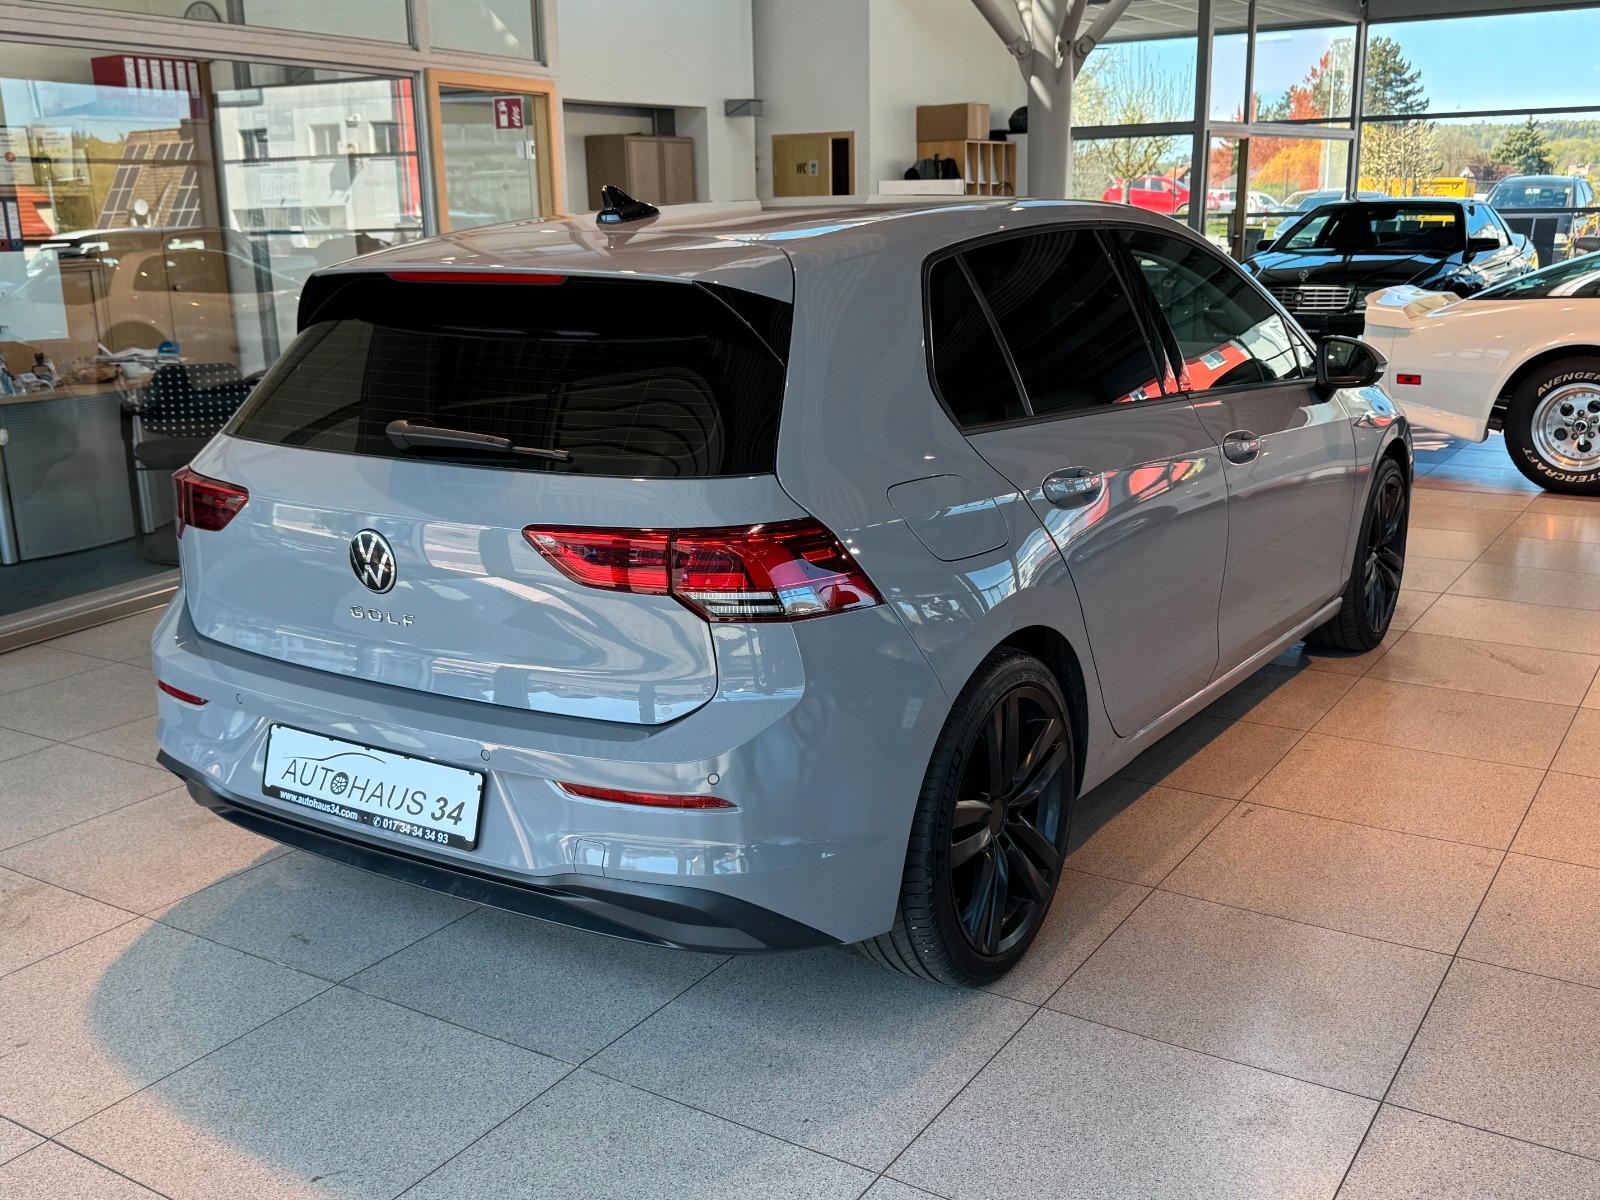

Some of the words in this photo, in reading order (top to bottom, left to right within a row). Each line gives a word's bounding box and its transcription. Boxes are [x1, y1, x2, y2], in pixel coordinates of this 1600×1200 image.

[1522, 447, 1600, 483] TERCRAFT
[350, 605, 415, 627] GOLF
[280, 790, 358, 820] www.autohaus34.com
[281, 758, 427, 816] AUTOHAUS
[430, 797, 466, 826] 34
